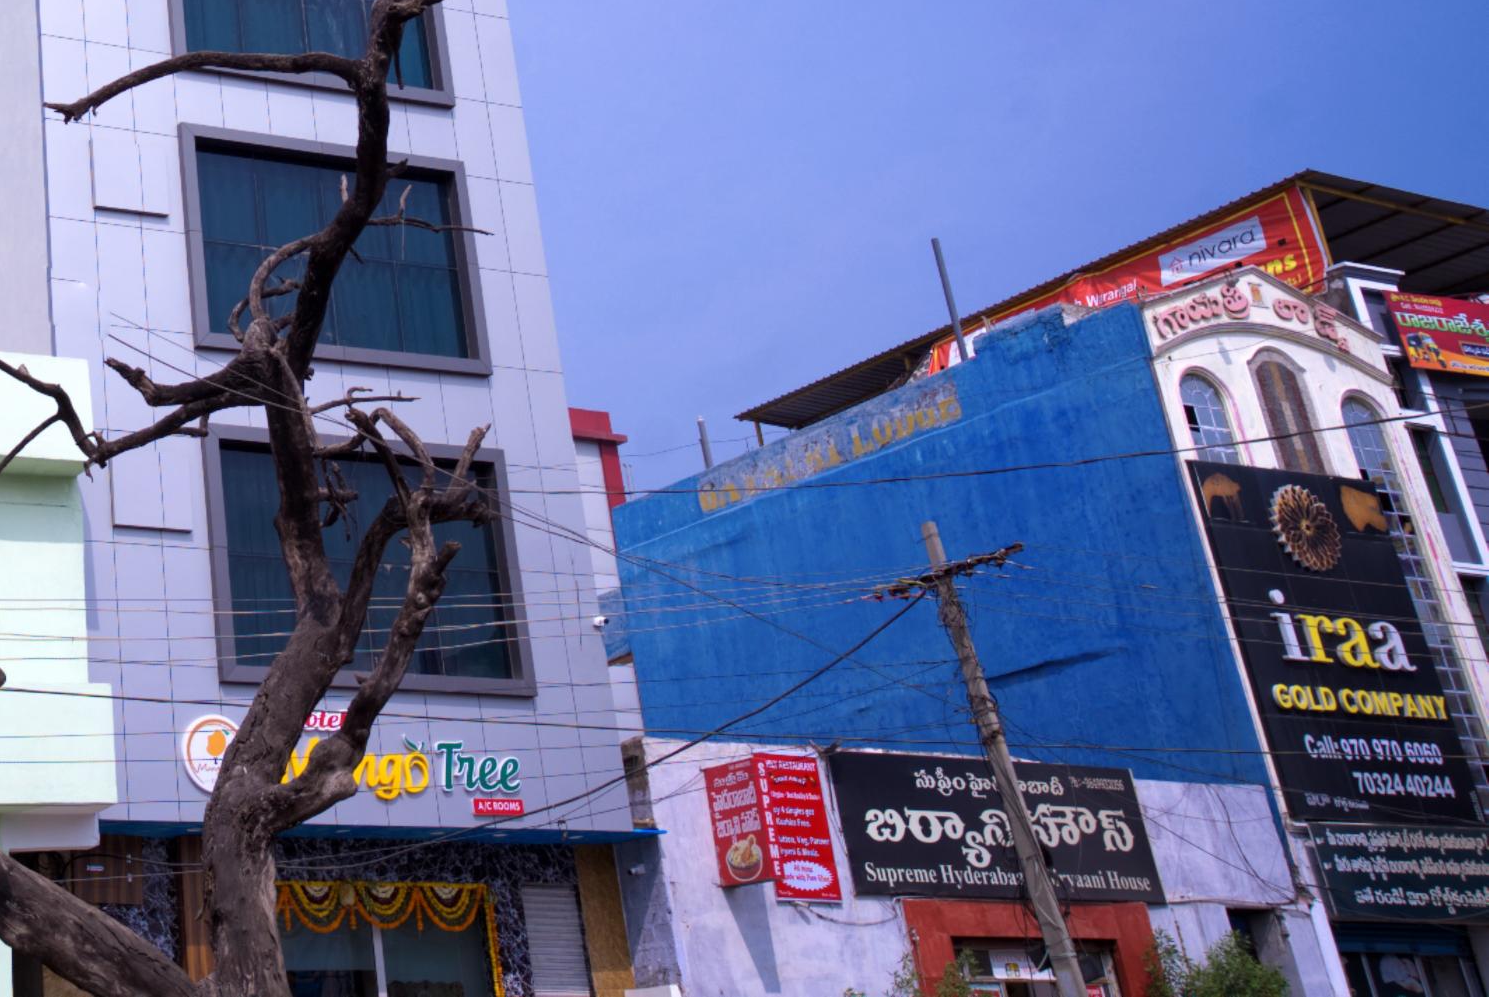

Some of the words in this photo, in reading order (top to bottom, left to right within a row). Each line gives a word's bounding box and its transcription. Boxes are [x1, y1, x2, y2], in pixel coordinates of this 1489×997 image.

[1188, 226, 1255, 267] nivara
[1267, 589, 1417, 673] iraa
[1271, 682, 1338, 714] GOLD
[1339, 684, 1448, 721] COMPANY
[303, 709, 349, 732] otel
[436, 740, 522, 793] Tree
[1304, 734, 1342, 759] Call:
[1340, 738, 1371, 761] 970
[1372, 738, 1404, 763] 970
[1404, 741, 1444, 765] 6060
[493, 801, 521, 812] ROOMS
[865, 861, 937, 887] Supreme
[1048, 867, 1106, 892] iryaani
[1110, 870, 1151, 892] House
